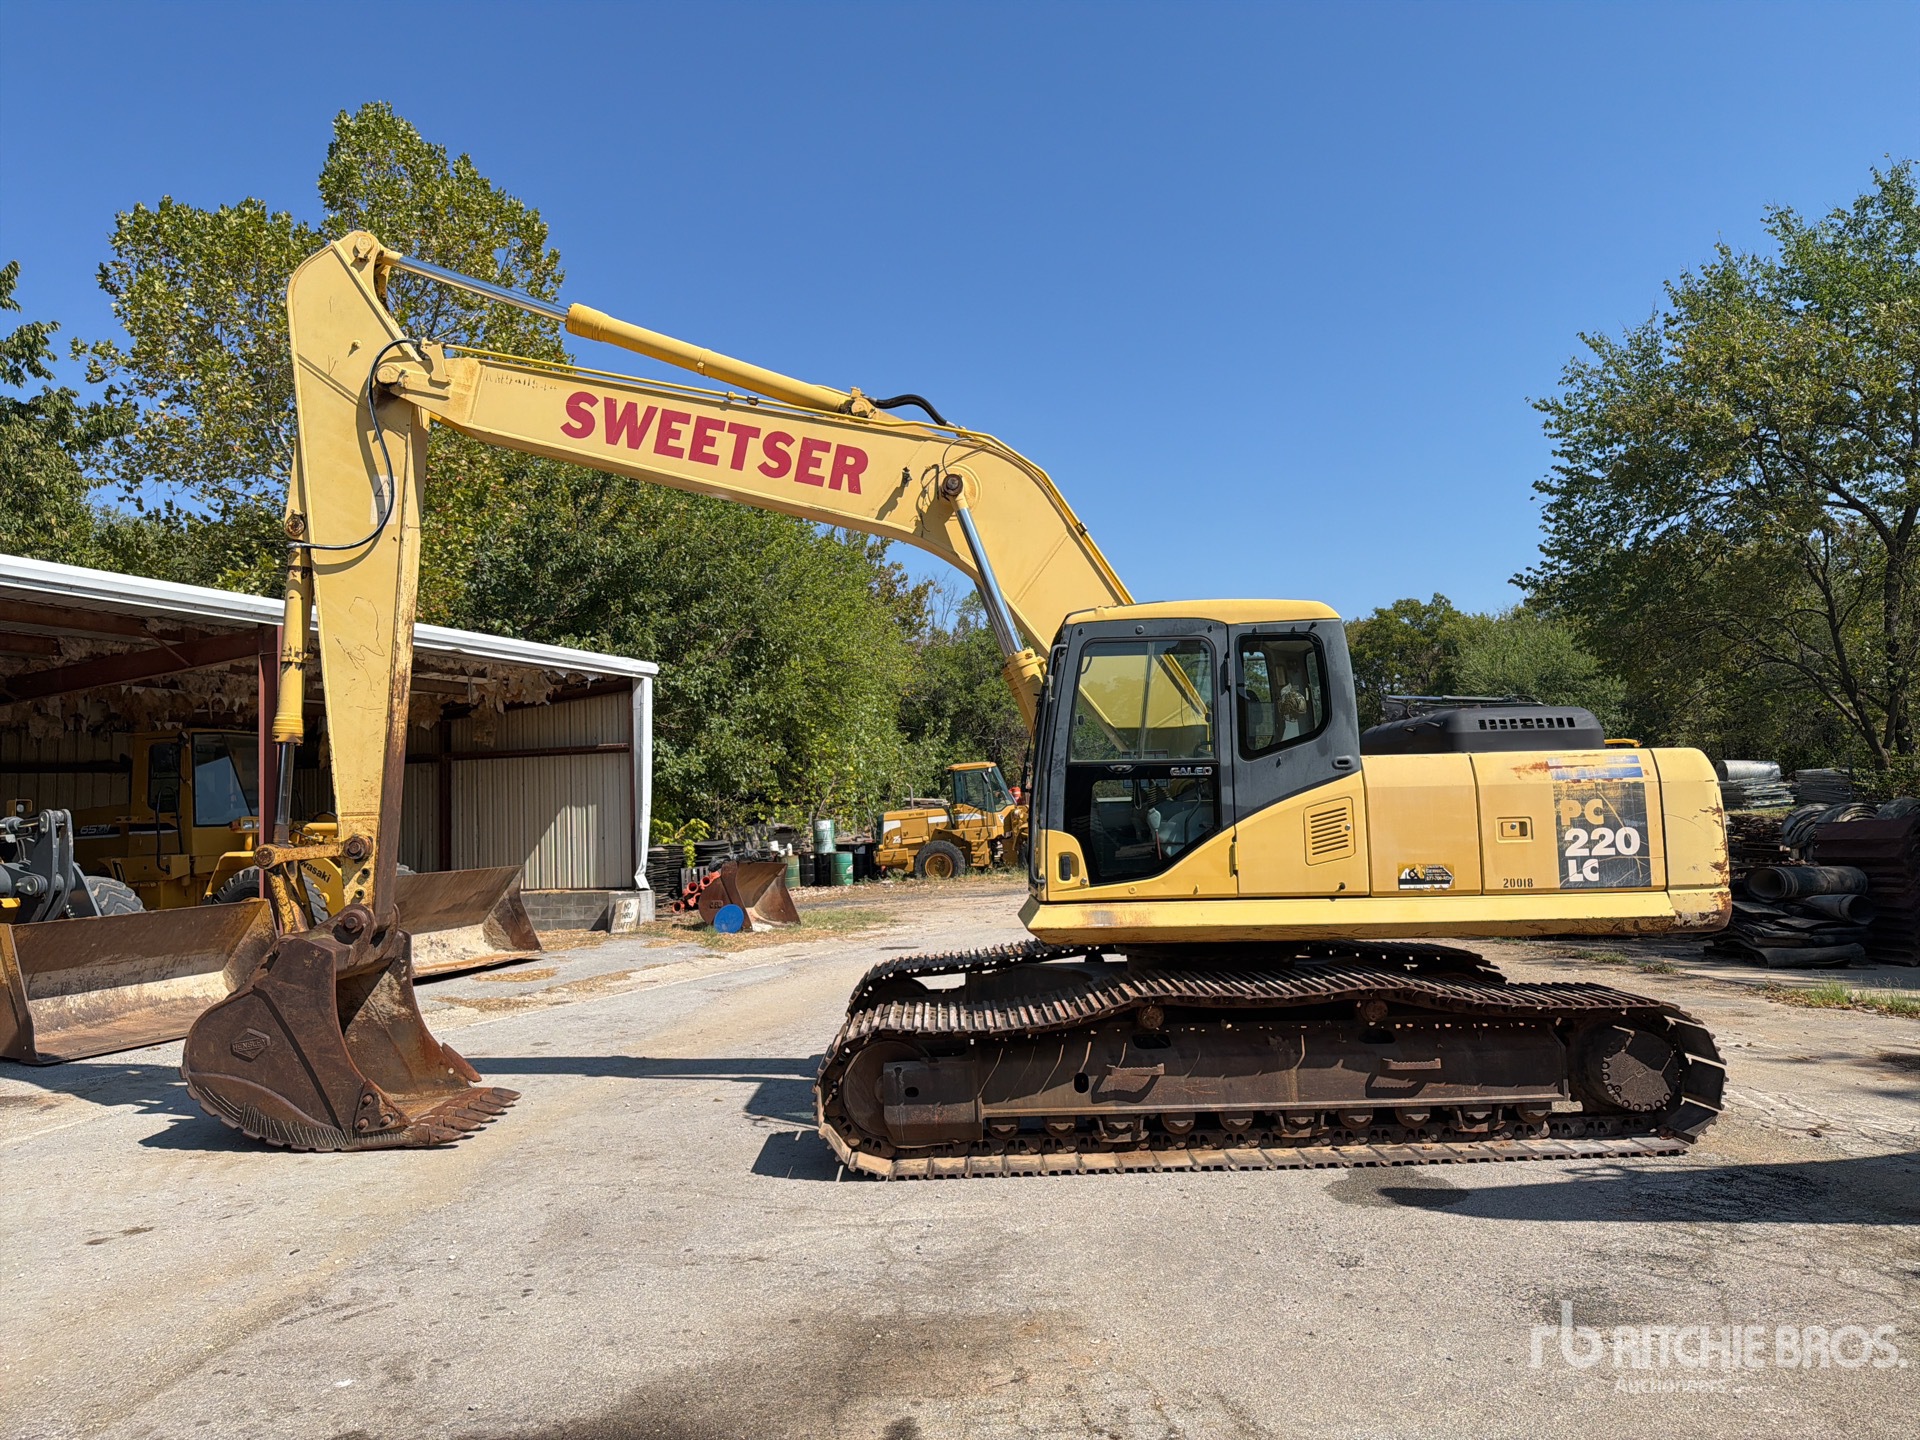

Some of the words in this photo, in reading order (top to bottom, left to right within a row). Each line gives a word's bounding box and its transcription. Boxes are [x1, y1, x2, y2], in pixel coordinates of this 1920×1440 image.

[560, 391, 868, 495] SWEETSER
[1561, 799, 1605, 826] PC
[1565, 827, 1640, 857] 220
[301, 861, 331, 883] wasaki
[1568, 859, 1600, 882] LC
[1503, 877, 1534, 889] 20018
[620, 912, 634, 920] THRU
[624, 902, 632, 912] NO
